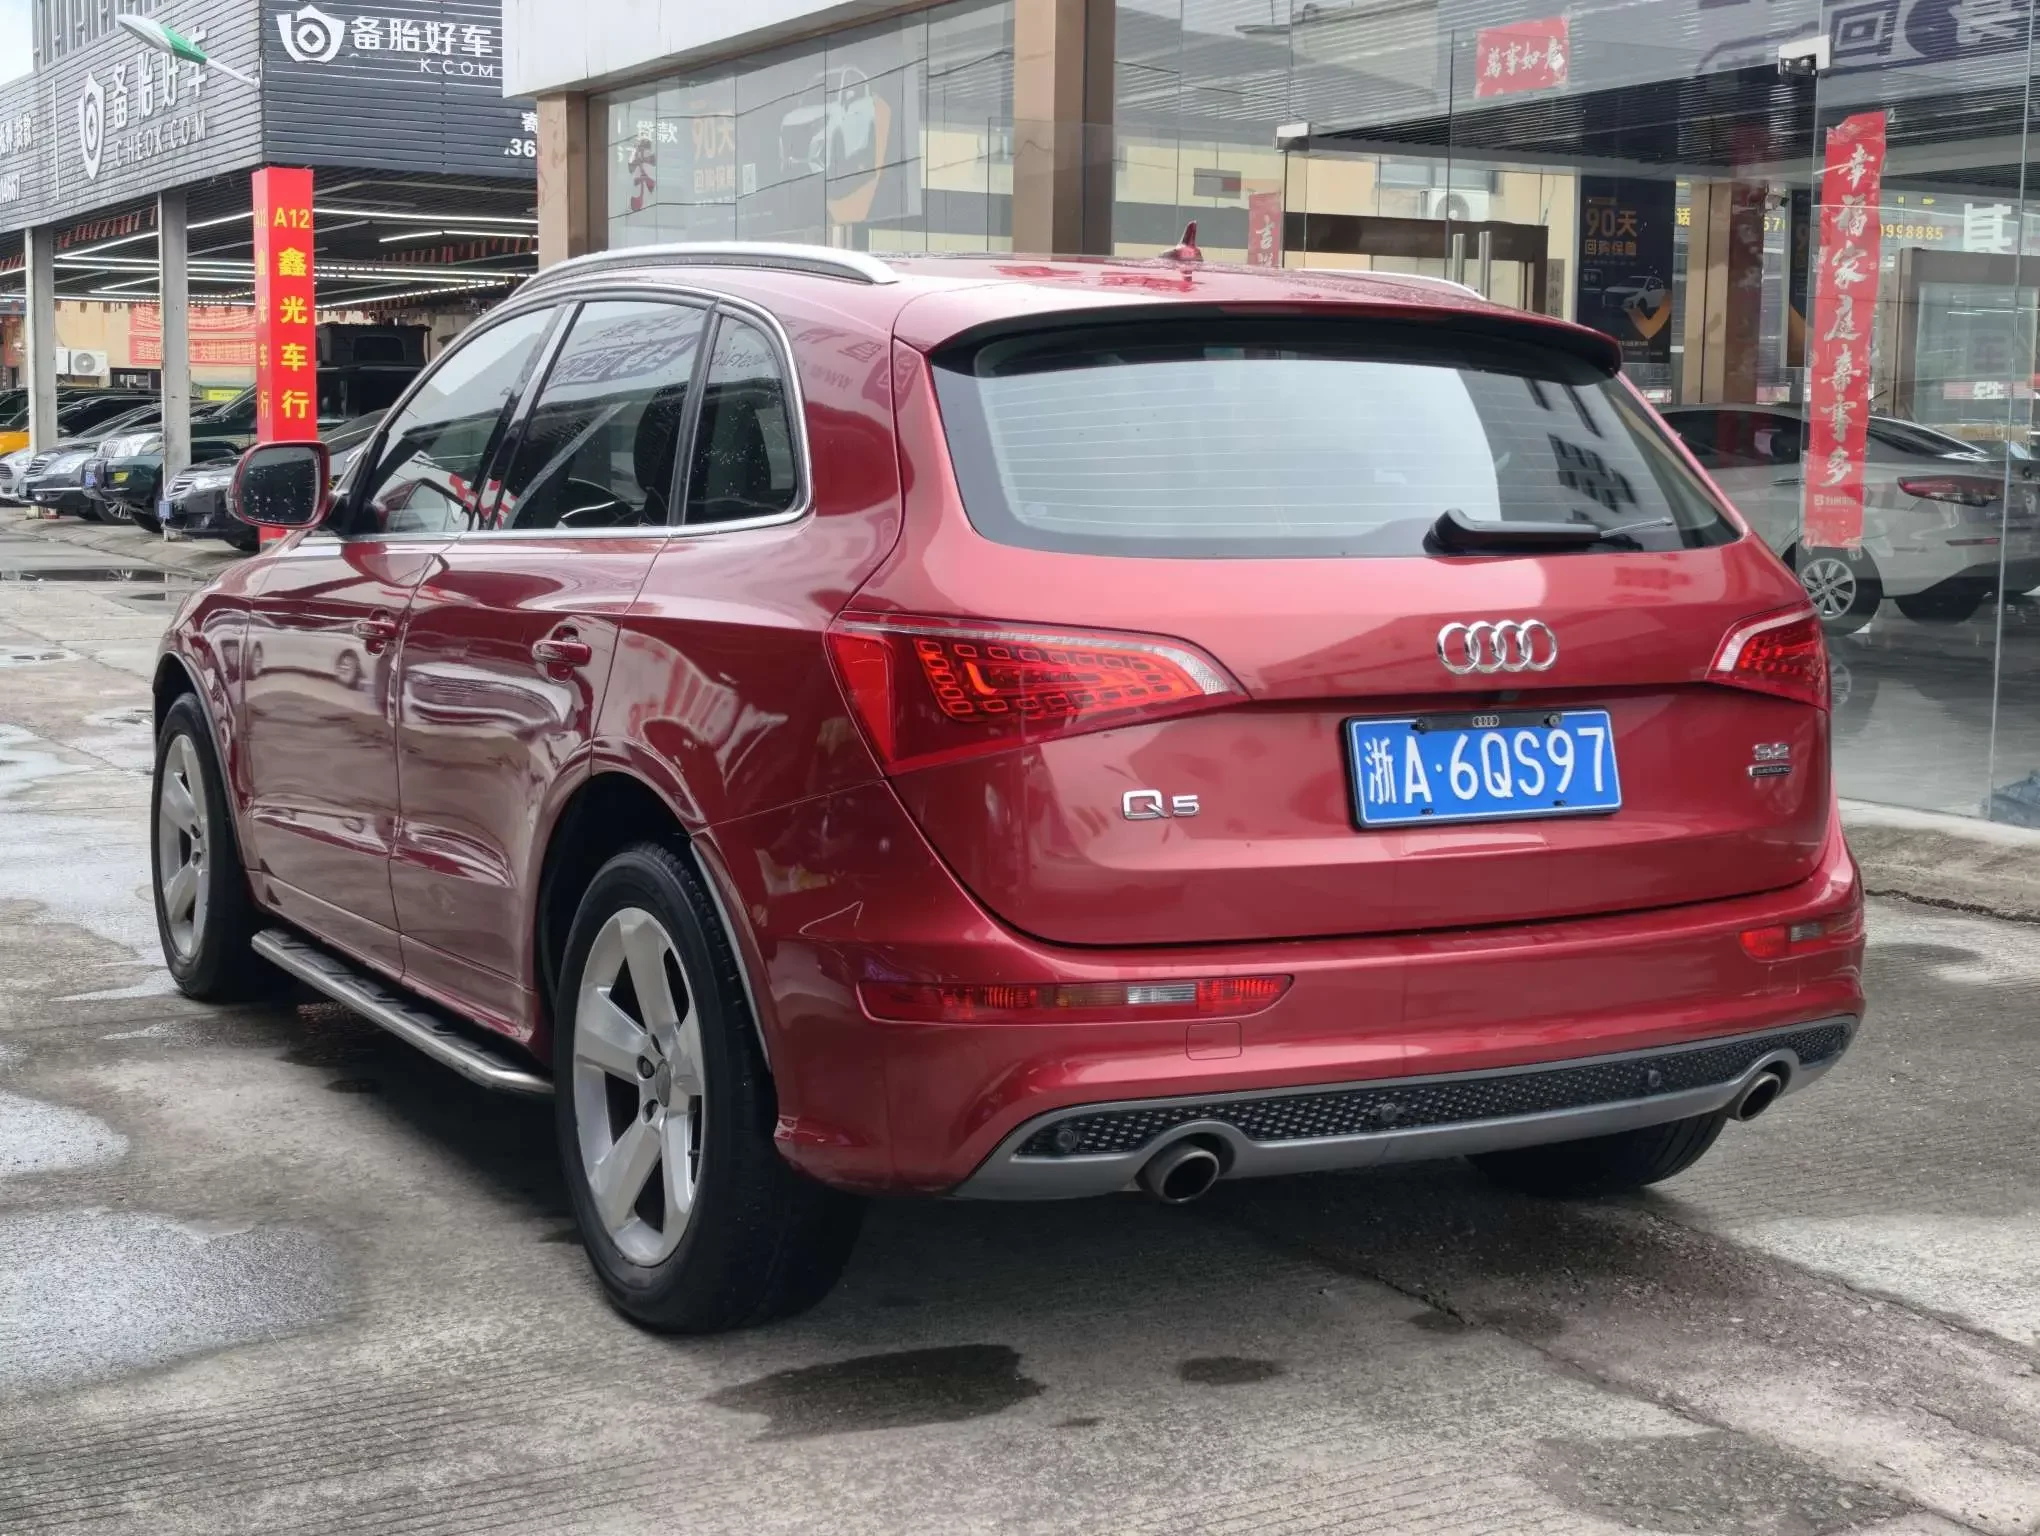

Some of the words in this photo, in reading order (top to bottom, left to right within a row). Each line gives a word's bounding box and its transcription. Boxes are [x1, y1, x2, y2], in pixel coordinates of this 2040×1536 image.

[351, 16, 493, 57] 备胎好车
[273, 207, 311, 229] A12
[1586, 208, 1638, 237] 90天
[278, 247, 310, 419] 鑫光车行
[1122, 789, 1200, 820] Q5
